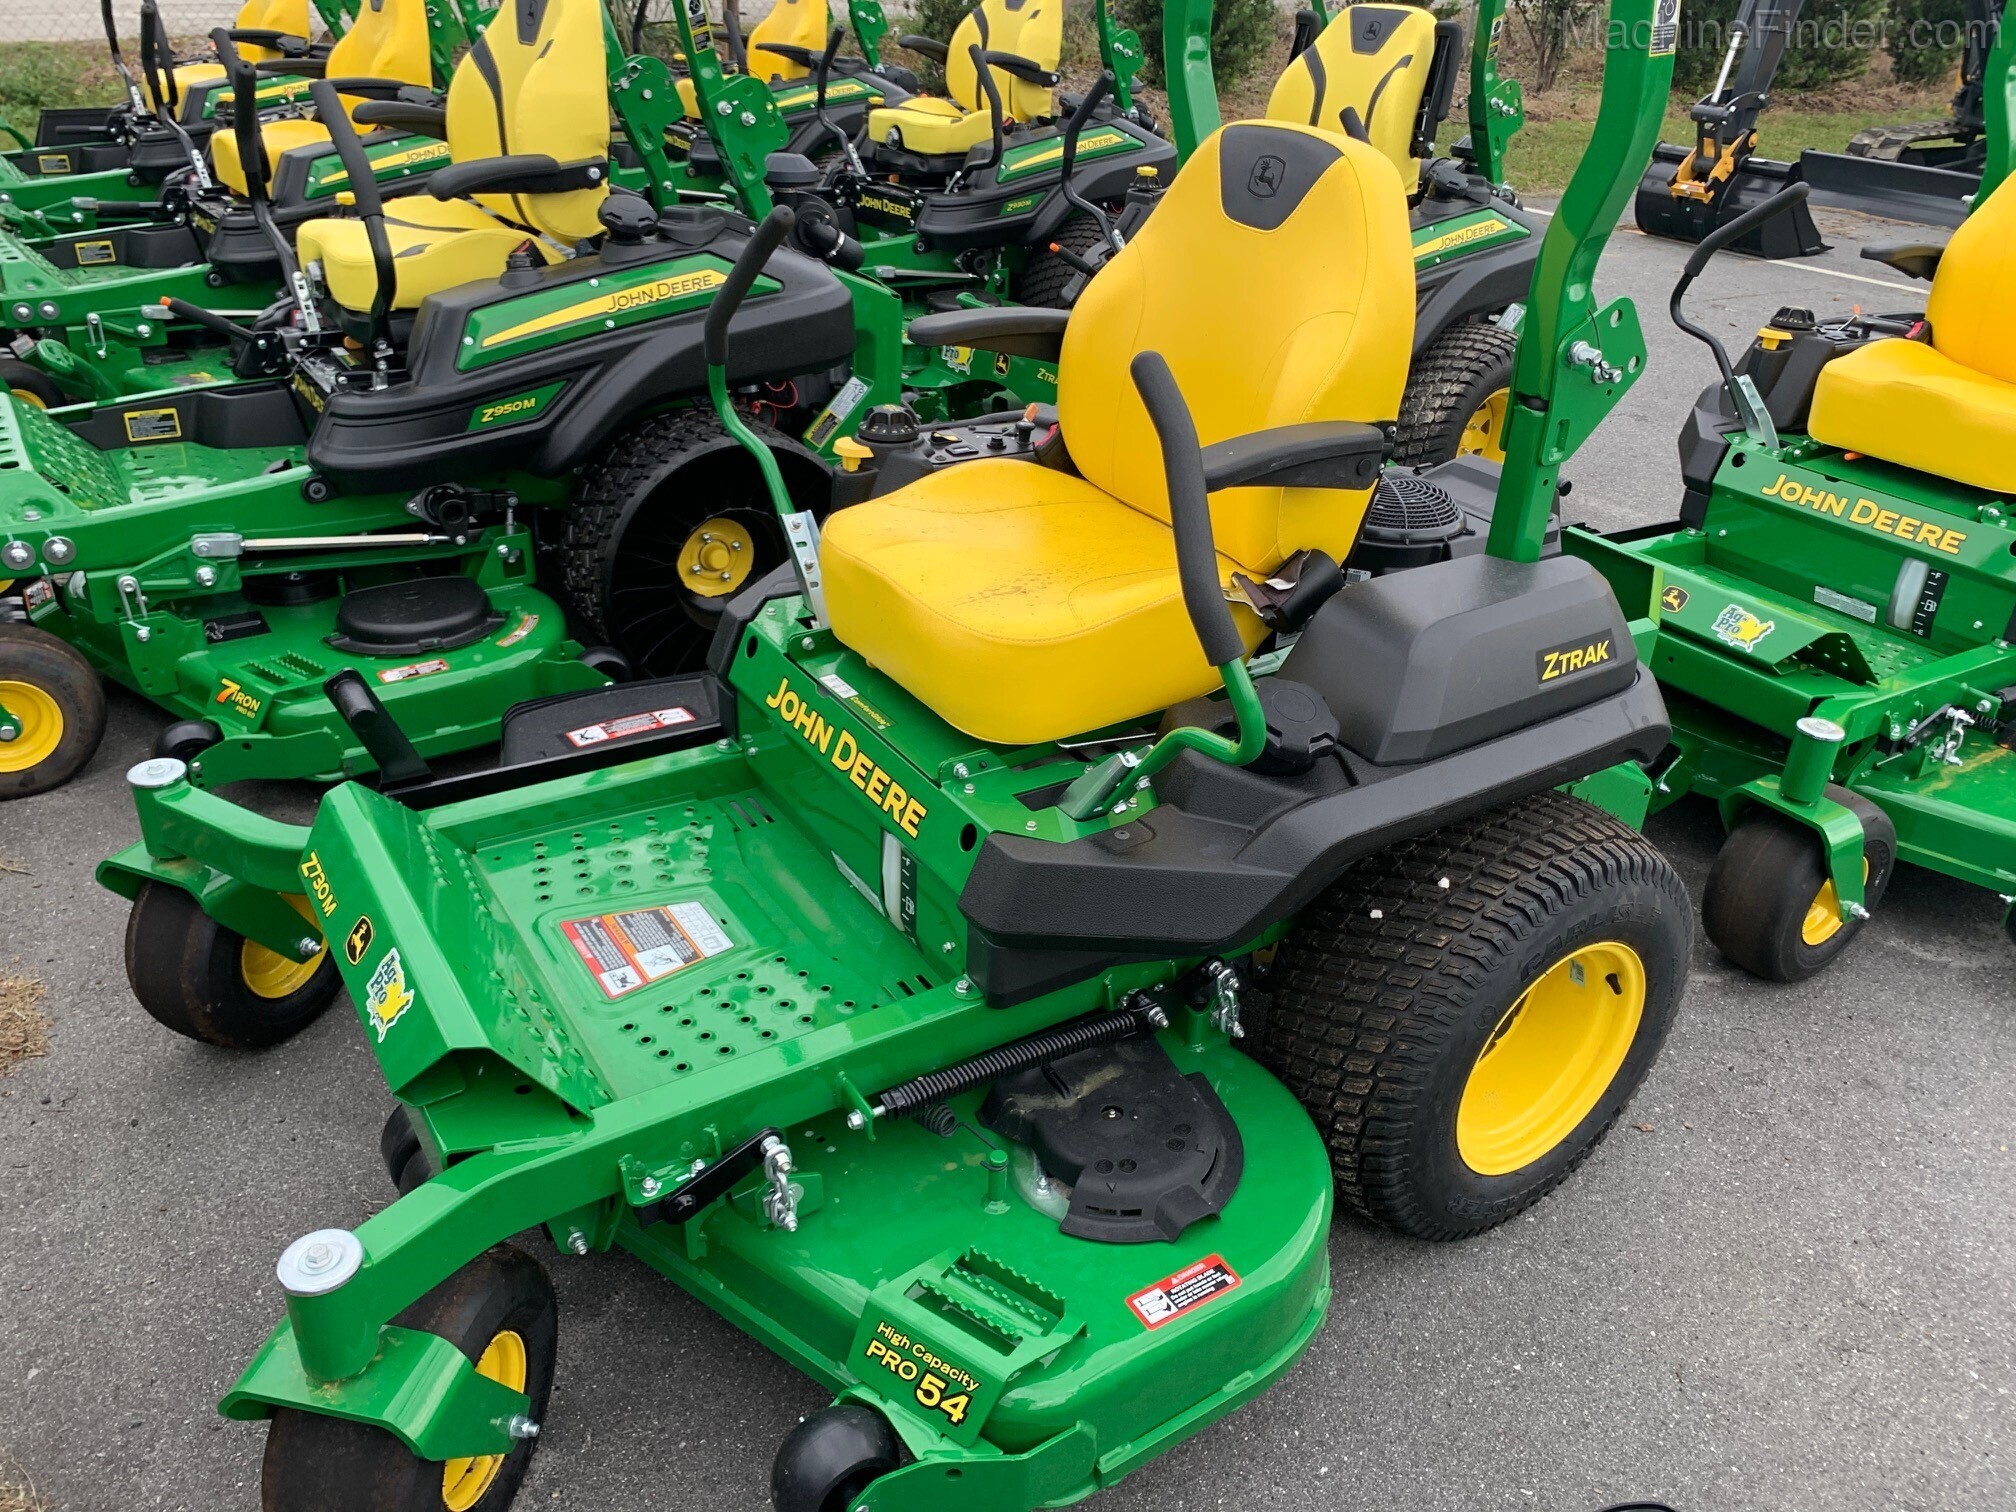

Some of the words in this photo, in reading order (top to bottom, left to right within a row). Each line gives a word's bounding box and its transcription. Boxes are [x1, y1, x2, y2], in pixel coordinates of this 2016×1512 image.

[404, 149, 437, 164] JOHN
[1088, 136, 1115, 150] DEERE
[860, 194, 882, 210] JOHN
[882, 199, 911, 219] DEERE
[1439, 233, 1465, 249] JOHN
[1465, 223, 1496, 240] DEERE
[608, 288, 655, 312] JOHN
[656, 274, 713, 299] DEERE
[1037, 367, 1060, 386] ZTRA
[481, 397, 536, 423] Z950M
[1761, 473, 1849, 518] JOHN
[1848, 497, 1967, 555] DEERE
[1716, 617, 1742, 634] Pro
[1541, 639, 1610, 681] ZTRAK
[765, 676, 836, 755] JOHN
[830, 728, 928, 840] DEERE
[301, 850, 338, 919] Z730M
[370, 973, 388, 1005] Pro
[876, 1321, 911, 1350] High
[912, 1343, 980, 1392] Capacity
[865, 1339, 918, 1381] PRO
[915, 1372, 970, 1424] 54
